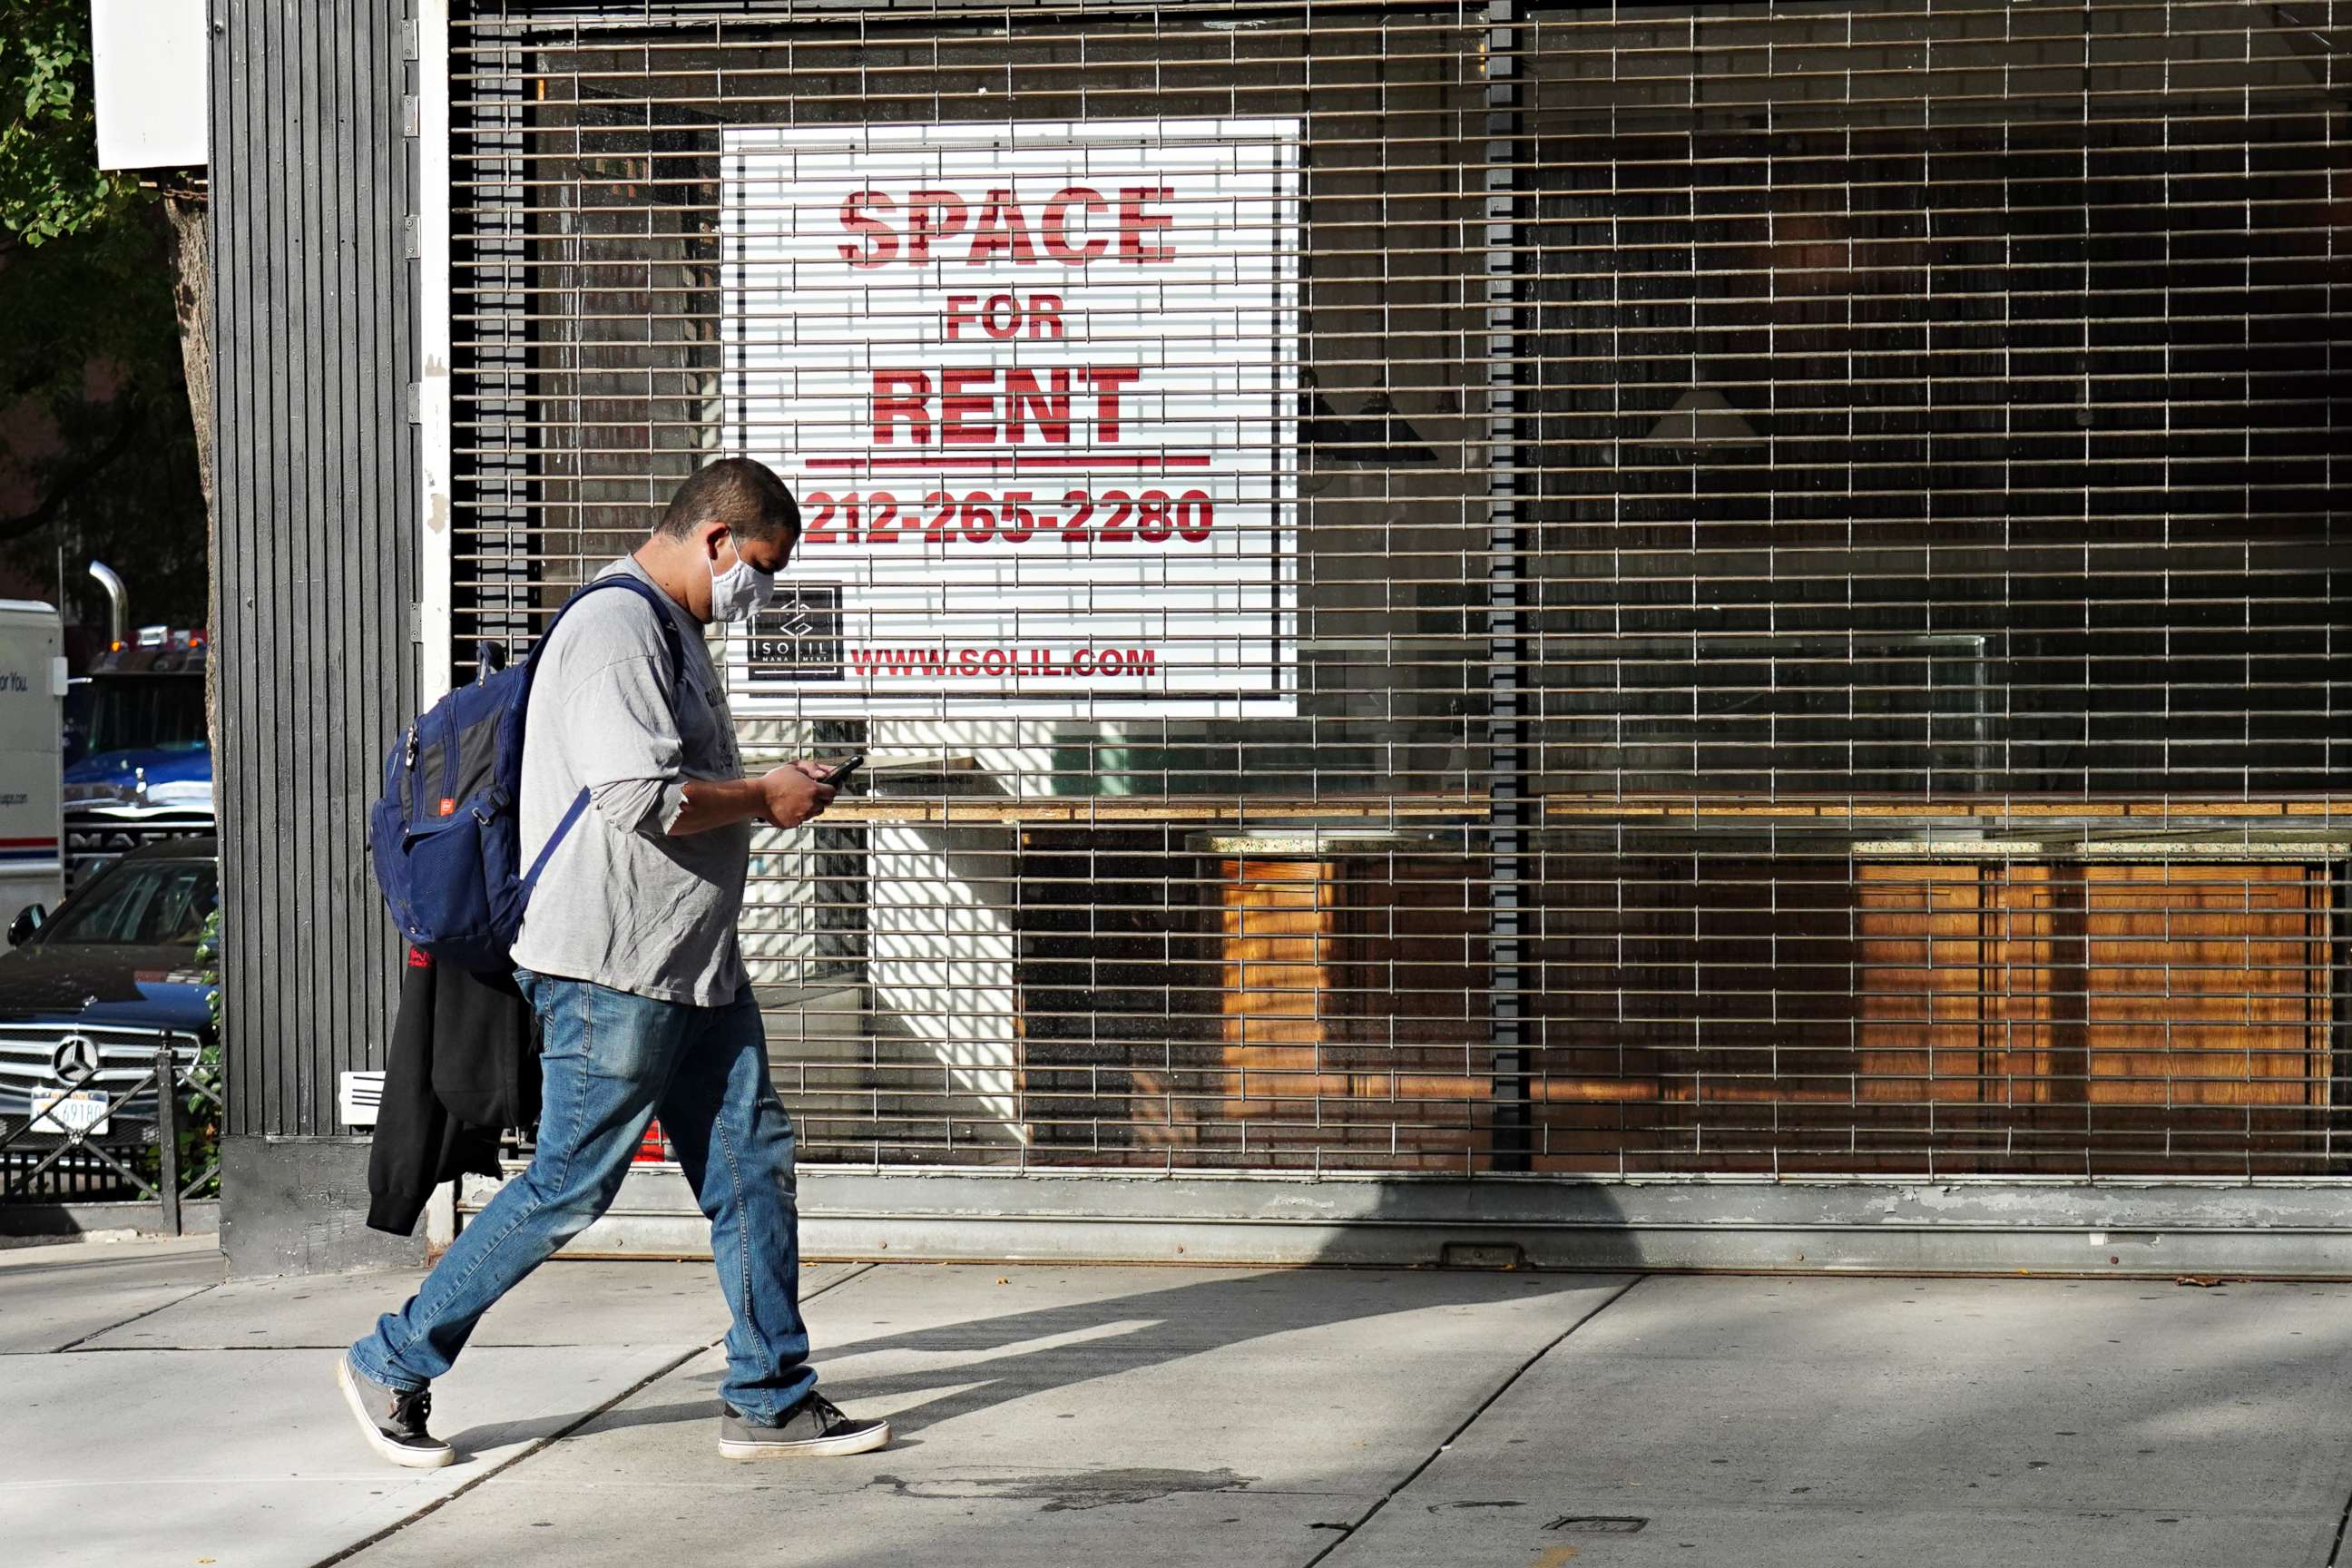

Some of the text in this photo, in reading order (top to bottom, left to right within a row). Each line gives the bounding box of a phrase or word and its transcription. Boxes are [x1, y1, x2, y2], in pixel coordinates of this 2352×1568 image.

[837, 186, 1178, 270] SPACE
[946, 292, 1065, 341] FOR
[872, 367, 1141, 446] RENT
[802, 489, 1215, 544] 212-265-2280
[761, 642, 827, 654] SOIL
[850, 648, 1157, 677] WWW.SOLIL.COM
